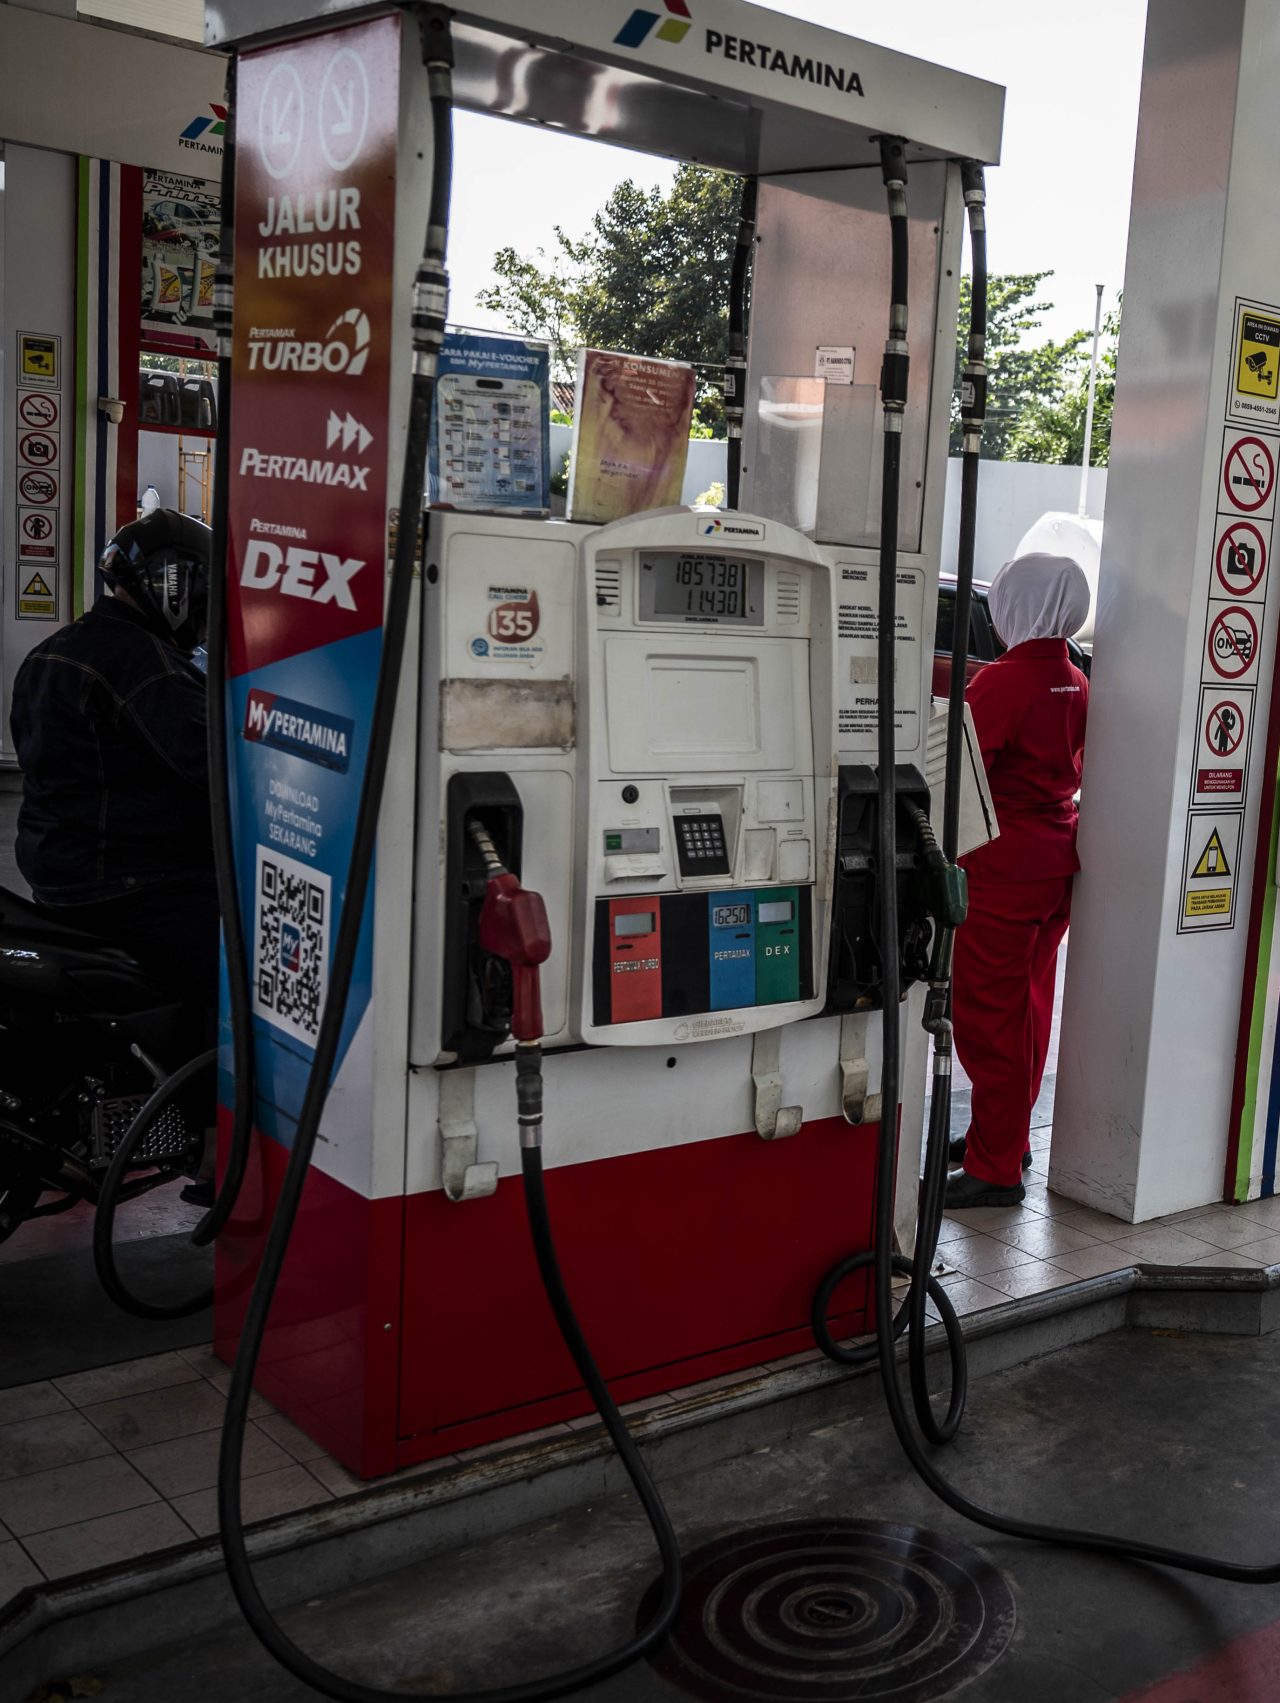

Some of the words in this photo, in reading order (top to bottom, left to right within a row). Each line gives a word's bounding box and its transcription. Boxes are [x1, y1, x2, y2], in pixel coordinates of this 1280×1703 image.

[705, 28, 865, 97] PERTAMINA
[178, 138, 225, 156] PERTAMIN
[258, 187, 362, 237] JALUR
[258, 241, 362, 279] KHUSUS
[249, 327, 296, 338] PERTAMAX
[1254, 332, 1270, 342] CCTV
[248, 341, 350, 373] TURBO
[623, 361, 680, 379] KONSUMEN
[239, 447, 371, 491] PERTAMAX
[250, 518, 307, 539] PERTAMINA
[723, 526, 760, 536] PERTAMINA
[240, 539, 367, 612] DEX
[676, 561, 738, 588] 185738
[490, 610, 533, 637] 135
[1216, 638, 1233, 650] ON
[248, 700, 347, 757] MyPERTAMINA
[269, 779, 320, 812] DOWNLOAD
[265, 799, 322, 837] MyPertamina
[269, 822, 316, 857] SEKARANG
[714, 906, 746, 925] 16250
[714, 949, 751, 961] PERTAMAX
[765, 945, 790, 956] DEX
